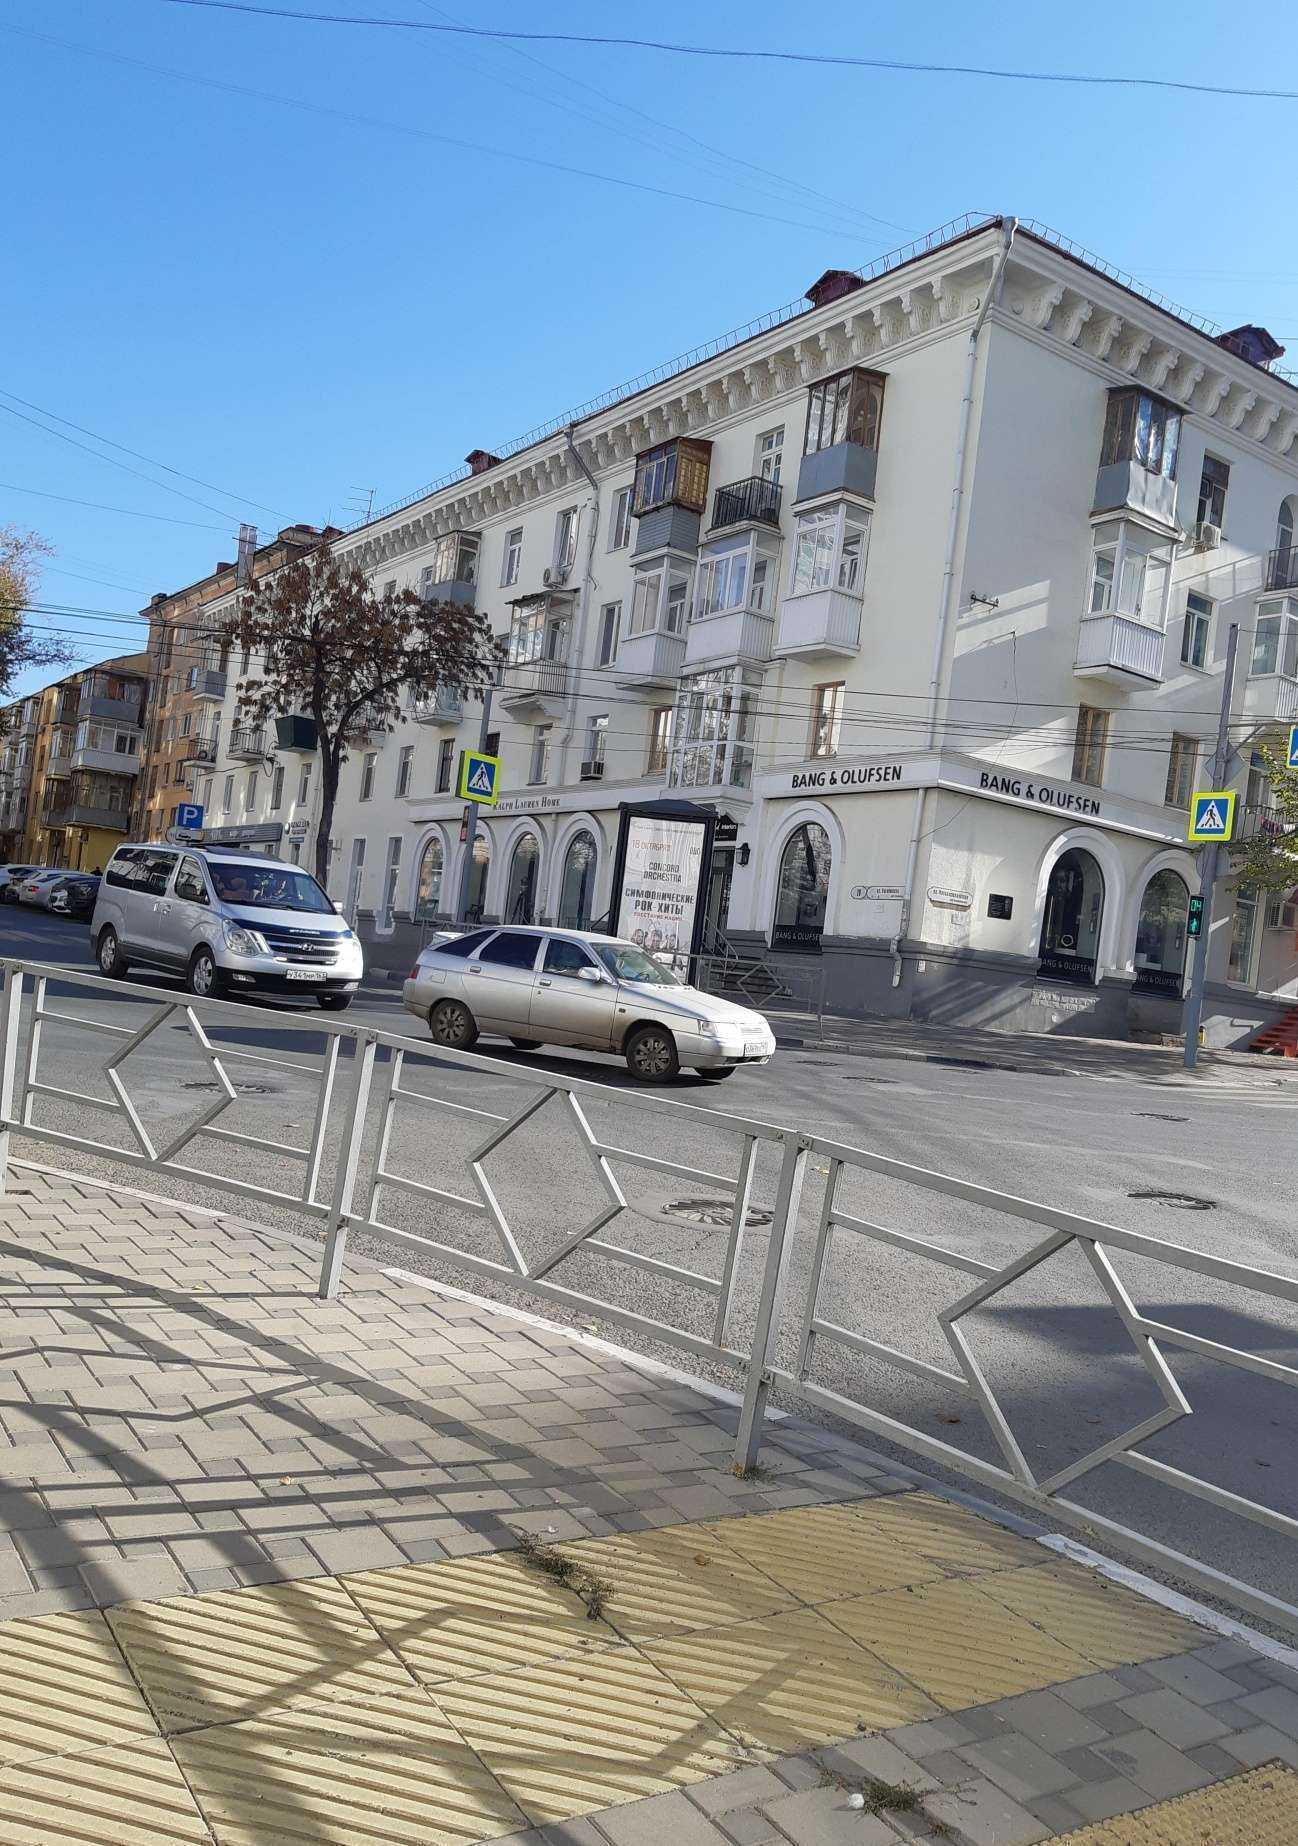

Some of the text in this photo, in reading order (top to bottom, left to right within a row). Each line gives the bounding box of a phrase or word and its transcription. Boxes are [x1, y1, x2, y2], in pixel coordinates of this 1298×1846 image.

[791, 765, 903, 788] BANG & OLUFSEN
[979, 772, 1101, 815] BANG & OLUFSEN
[183, 806, 198, 824] P
[648, 862, 680, 873] CONCORD
[643, 871, 682, 883] ORCHESTRA
[625, 888, 695, 904] СИМФОНИЧЕСКИЕ
[634, 899, 684, 915] РОК-ХИТЫ
